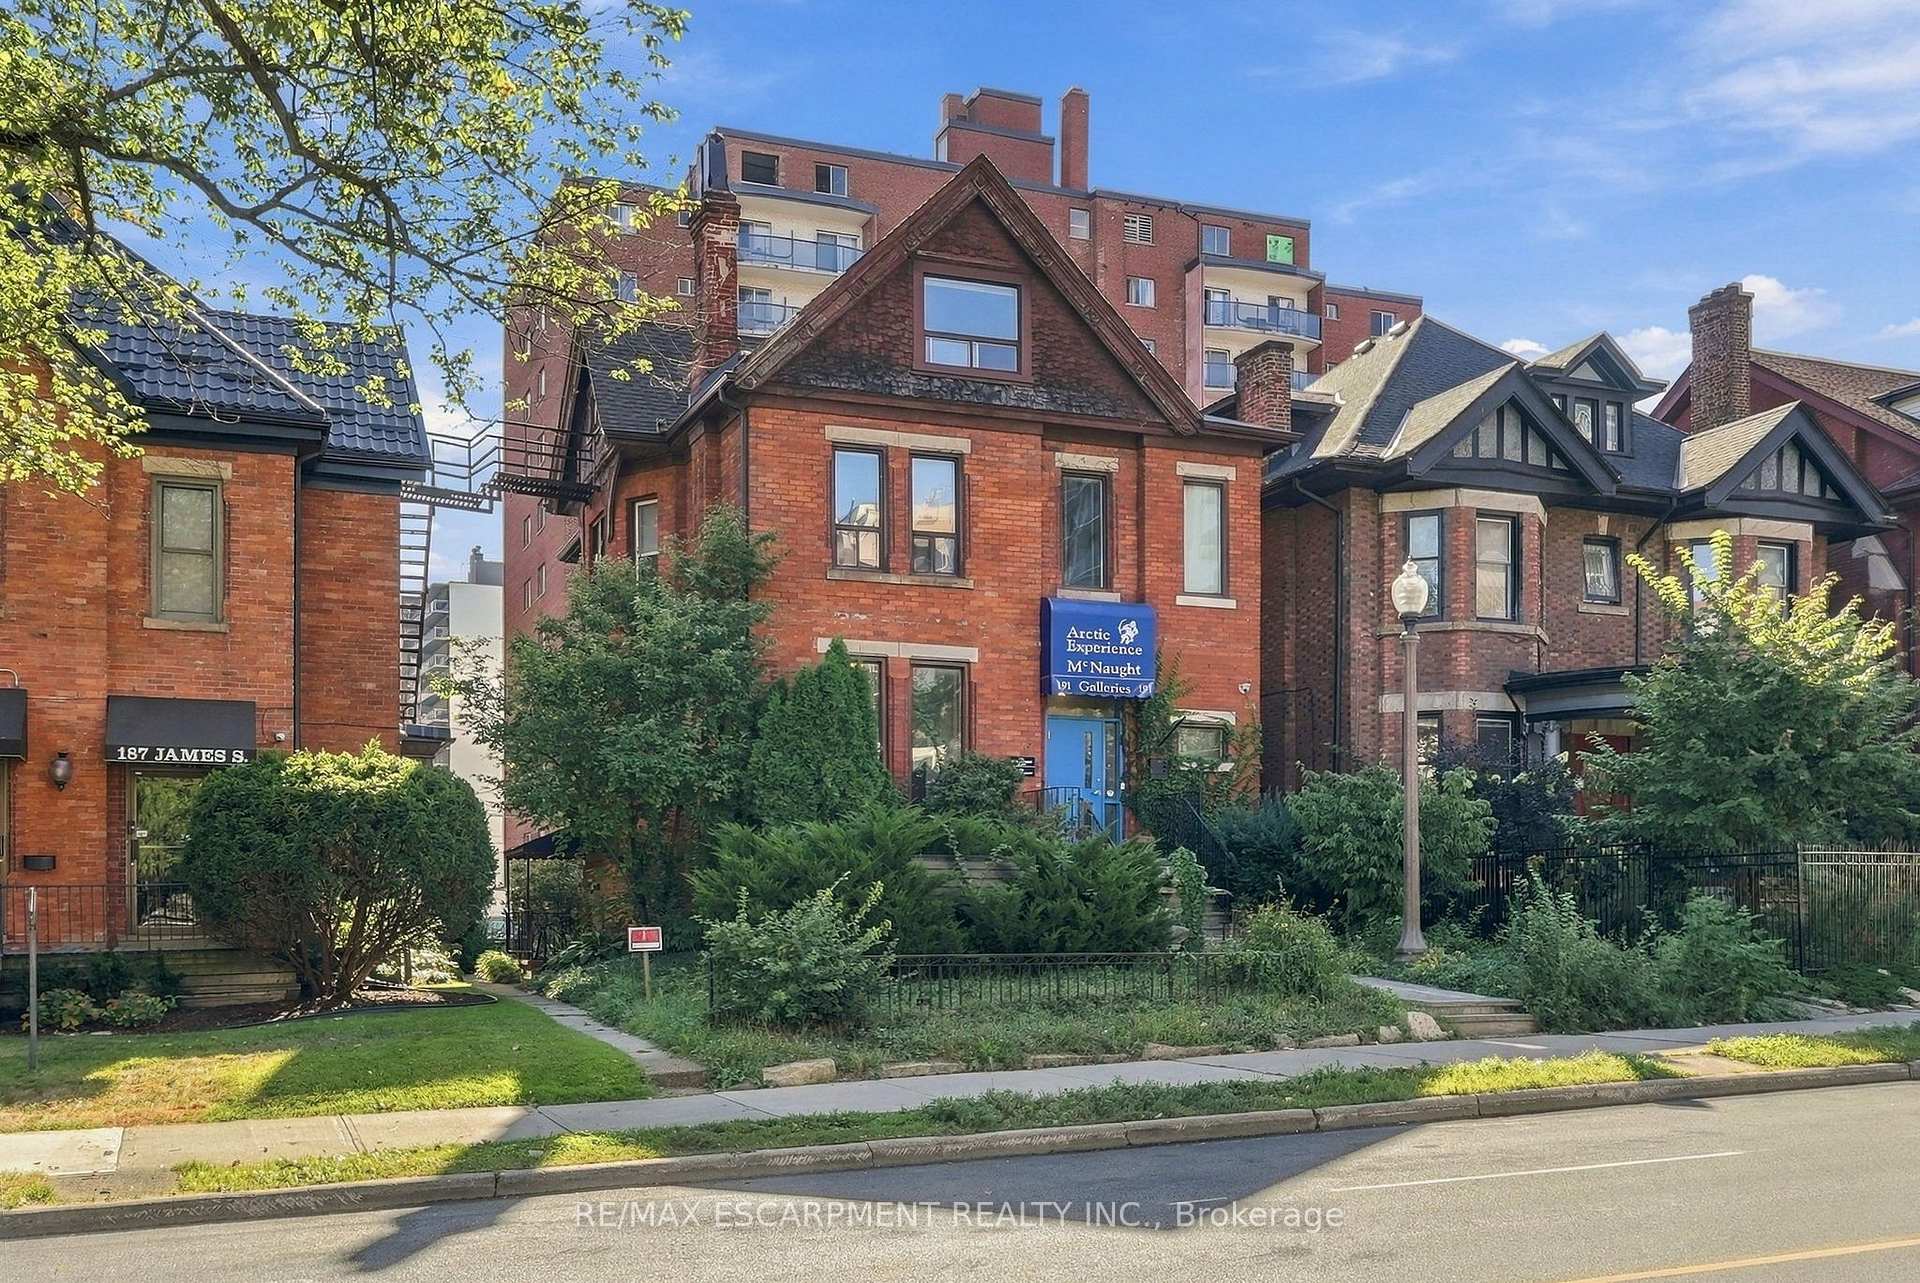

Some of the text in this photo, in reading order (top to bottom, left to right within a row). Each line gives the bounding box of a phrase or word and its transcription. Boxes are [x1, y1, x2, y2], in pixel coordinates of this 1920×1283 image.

[1066, 626, 1111, 641] Arctic
[1066, 638, 1143, 656] Experience
[1079, 680, 1131, 694] Galleries
[117, 747, 249, 763] 187 JAMES S.
